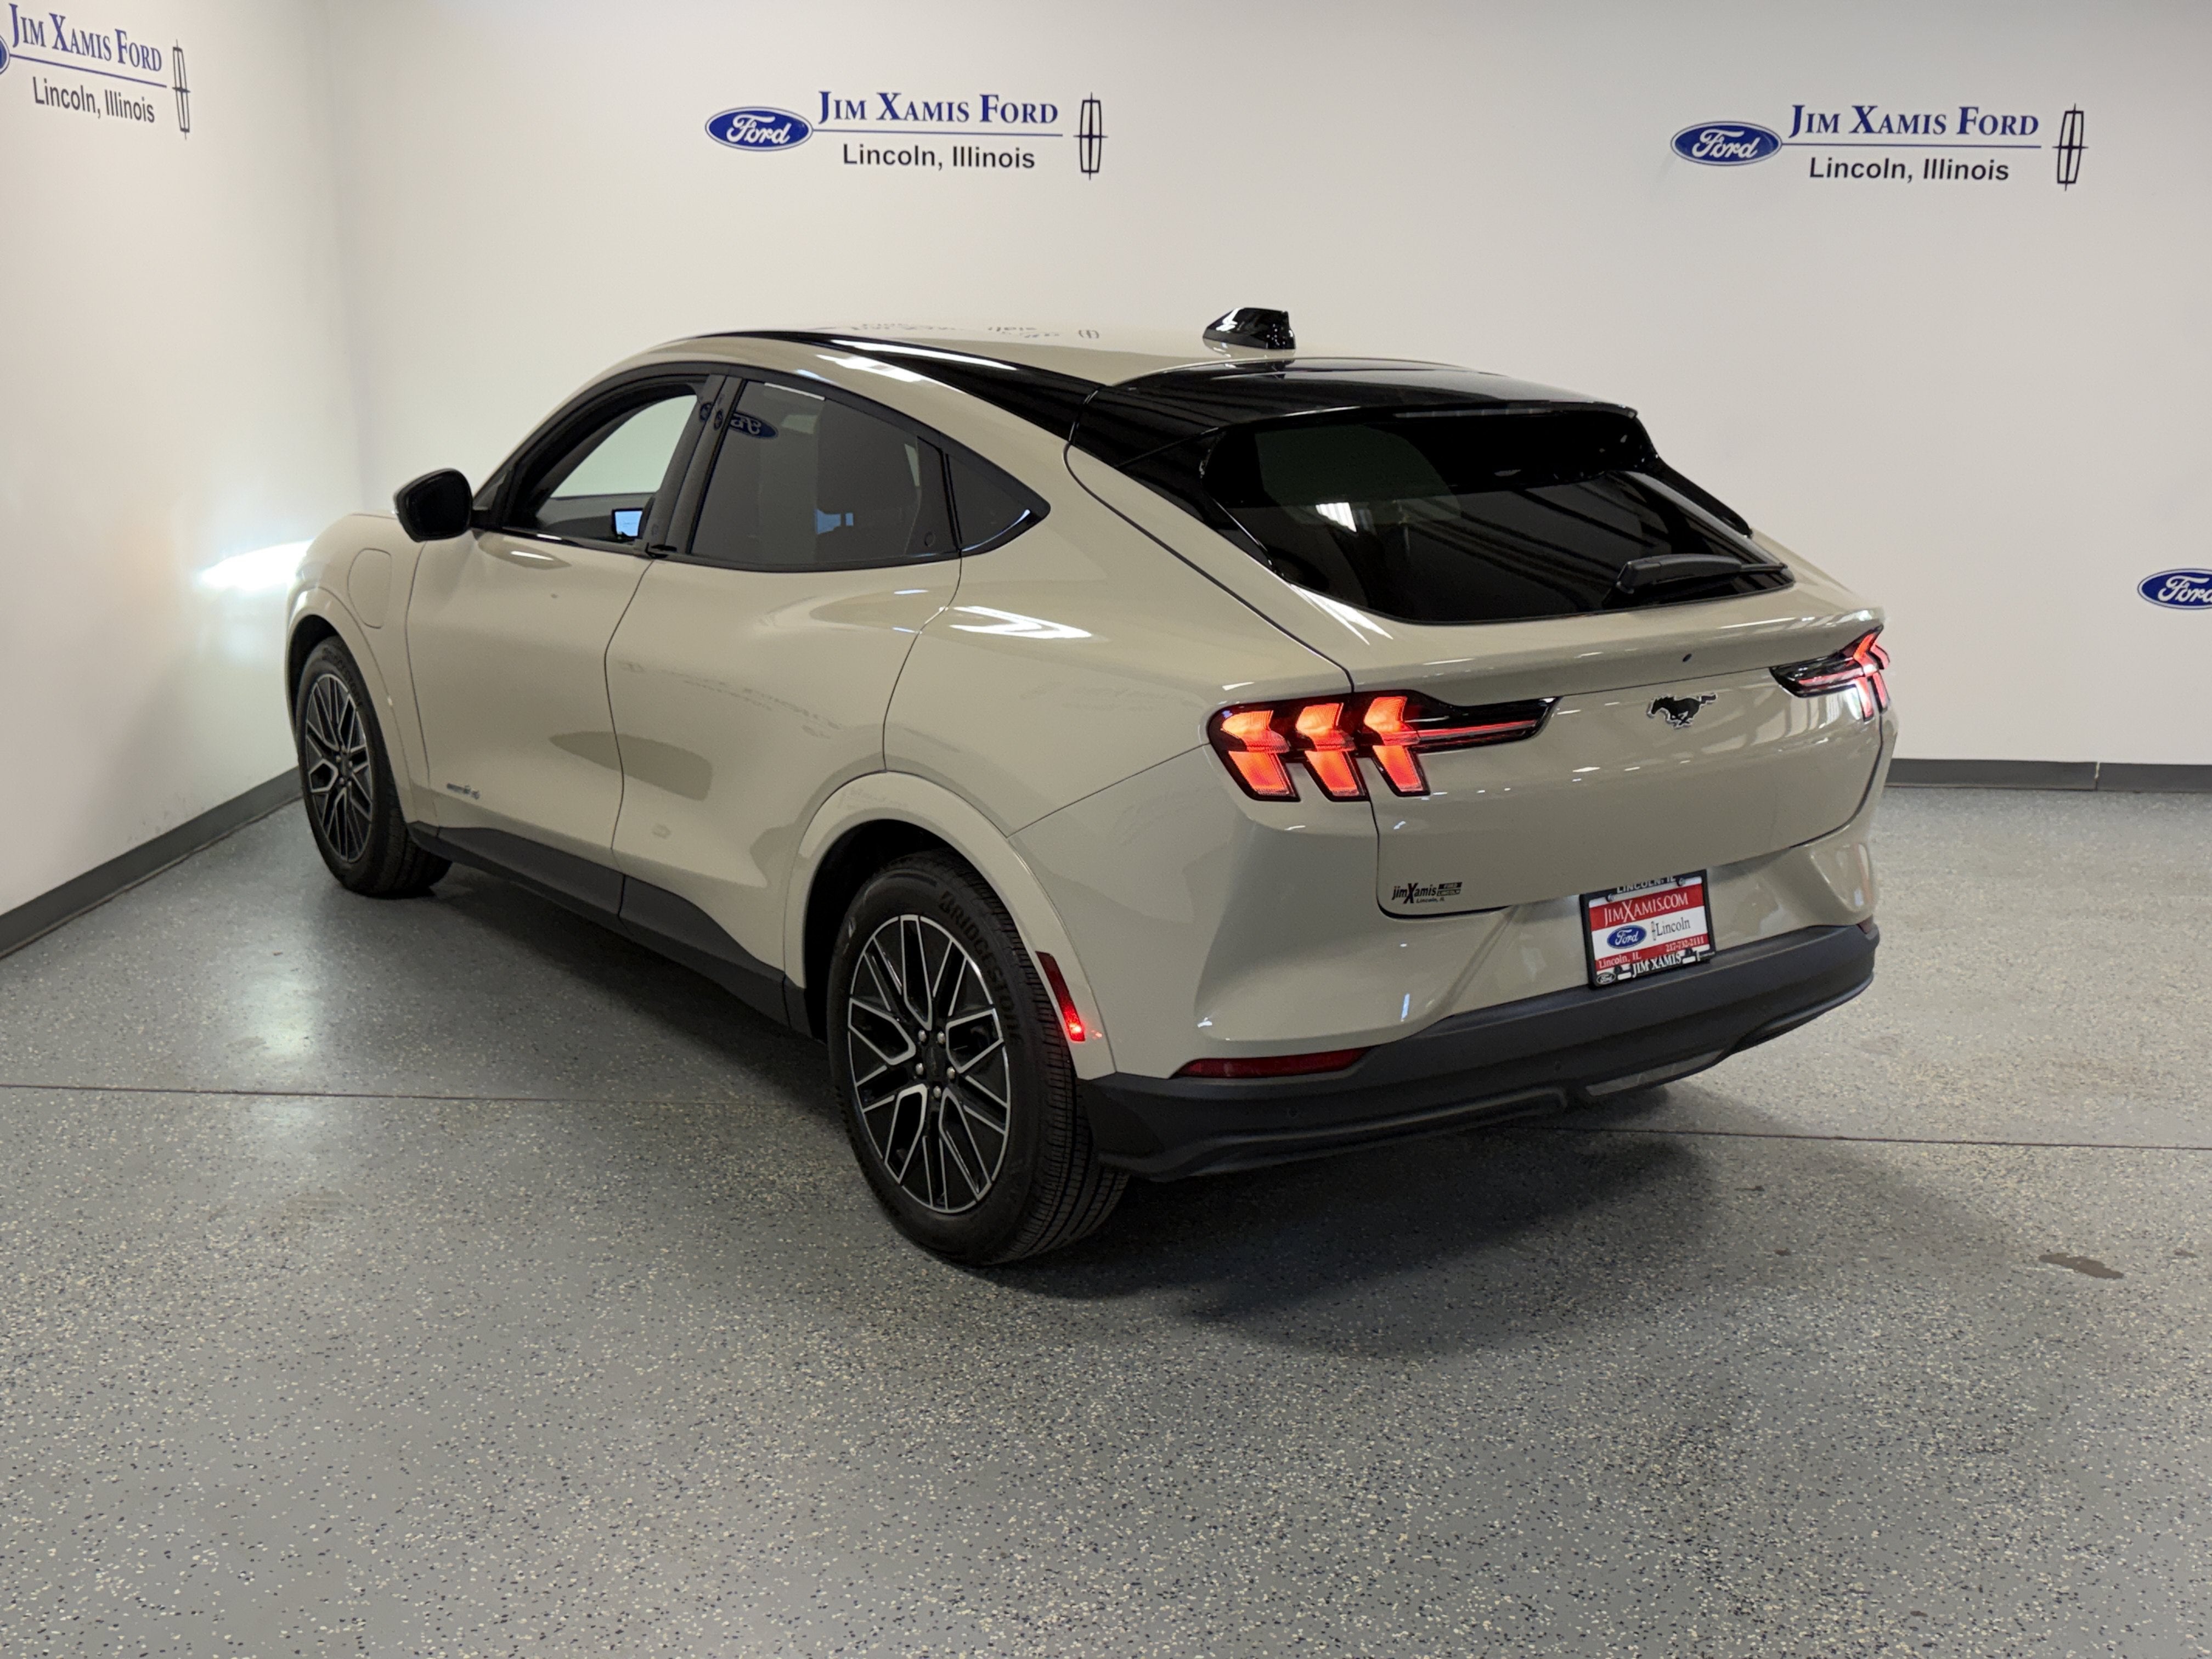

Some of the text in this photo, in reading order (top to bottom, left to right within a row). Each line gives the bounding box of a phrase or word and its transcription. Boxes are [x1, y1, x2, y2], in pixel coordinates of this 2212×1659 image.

[8, 3, 162, 72] JIM XAMIS FORD
[33, 76, 155, 123] Lincoln, Illinois
[819, 91, 1058, 125] JIM XAMIS FORD
[726, 114, 792, 144] Ford
[1788, 105, 2039, 138] JIM XAMIS FORD
[843, 144, 1035, 171] Lincoln, Illinois
[1691, 128, 1761, 159] Ford
[1810, 157, 2010, 183] Lincoln, Illinois
[1603, 892, 1689, 927] JIMXAMIS.COM
[1615, 929, 1639, 946] Ford
[1656, 917, 1691, 936] Lincoln
[1632, 953, 1681, 978] JIM XAMIS
[1633, 952, 1642, 961] IL
